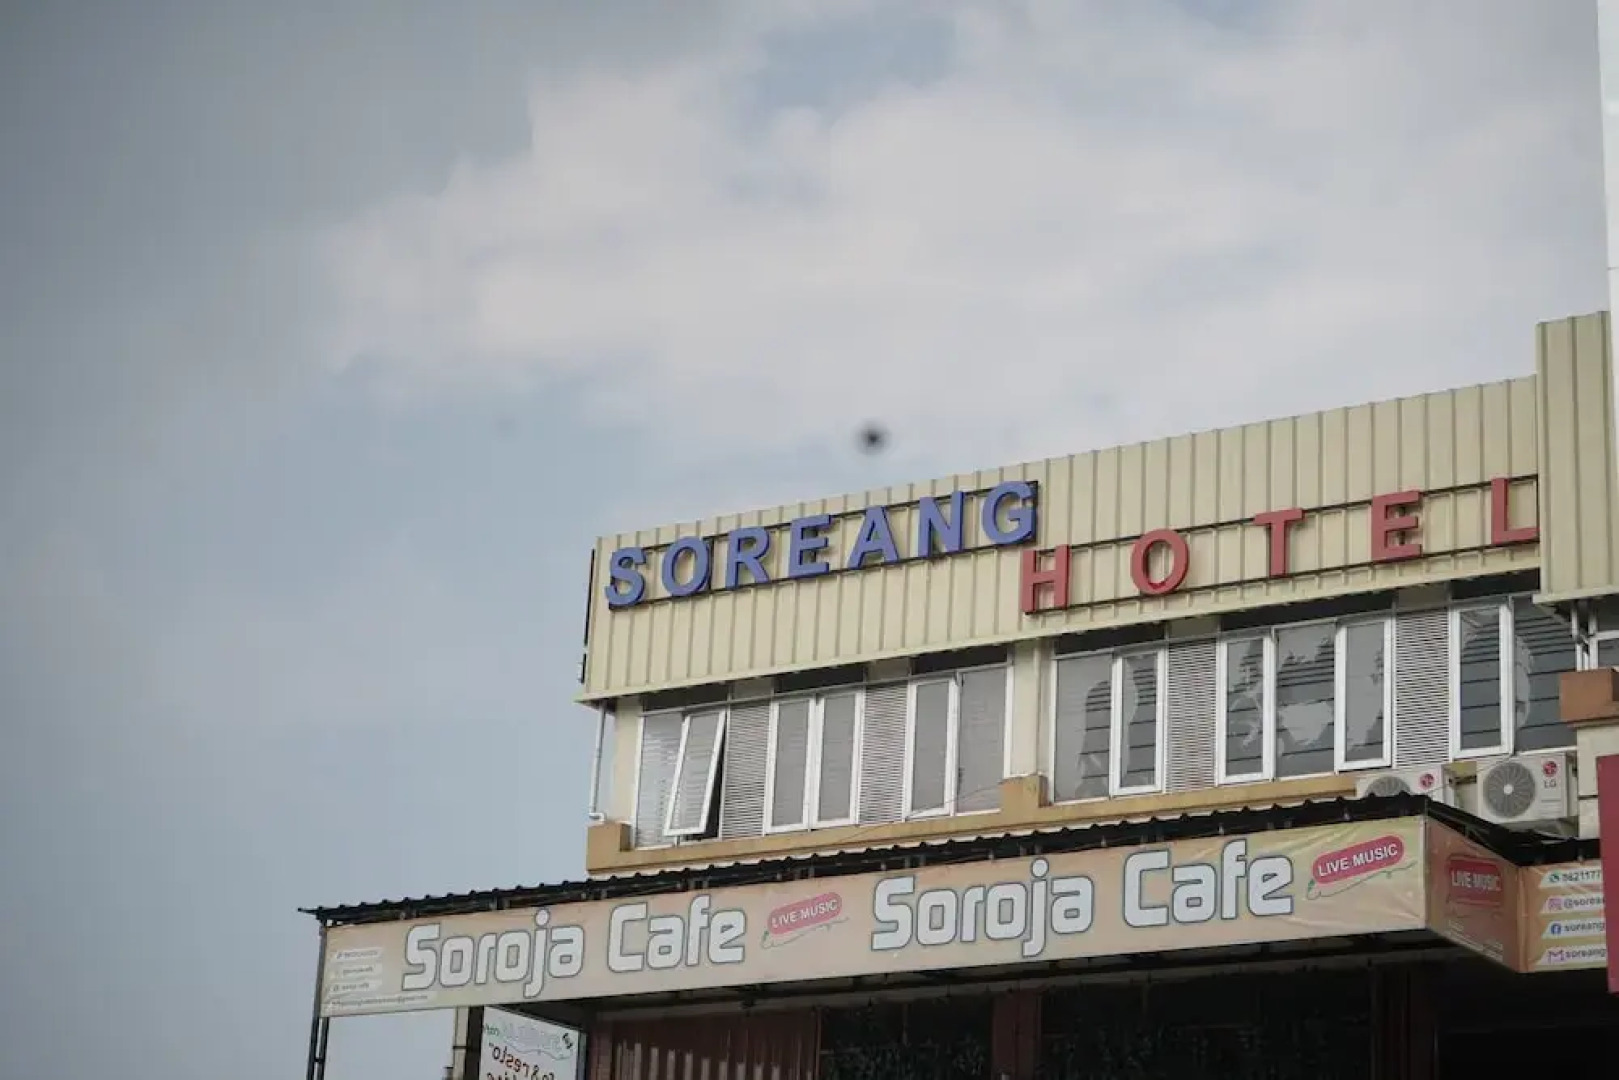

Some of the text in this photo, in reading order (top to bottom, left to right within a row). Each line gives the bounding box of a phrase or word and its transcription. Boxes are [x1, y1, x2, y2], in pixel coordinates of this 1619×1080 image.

[604, 481, 1037, 608] SOREANG
[1022, 476, 1540, 614] HOTEL
[1544, 779, 1557, 789] LG
[871, 838, 1294, 958] Soroja Cafe
[1317, 842, 1399, 877] LIVE MUSIC
[402, 894, 746, 999] Soroja Cafe
[771, 899, 838, 929] LIVE MUSIC
